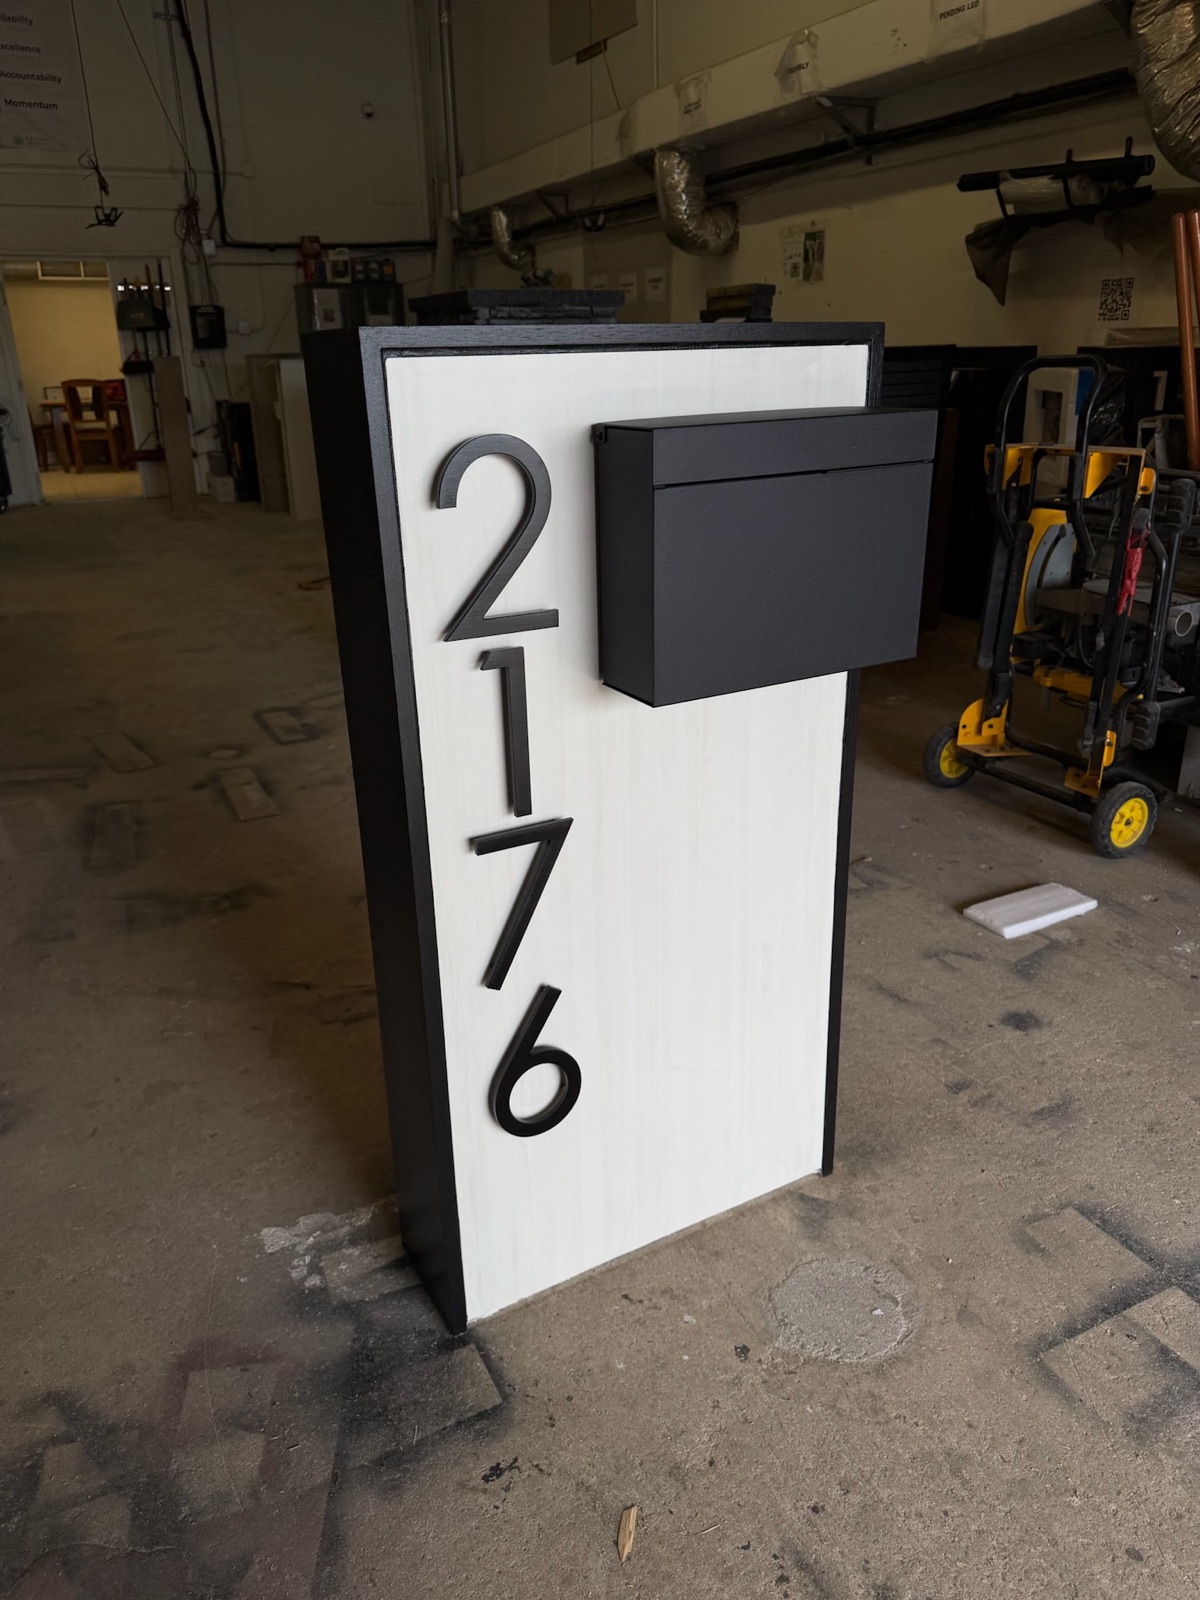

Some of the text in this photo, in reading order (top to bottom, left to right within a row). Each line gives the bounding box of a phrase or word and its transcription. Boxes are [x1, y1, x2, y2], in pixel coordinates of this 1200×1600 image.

[967, 0, 980, 10] LED
[0, 70, 62, 84] Accountability
[4, 98, 58, 110] Momentum
[435, 433, 582, 1138] 2176
